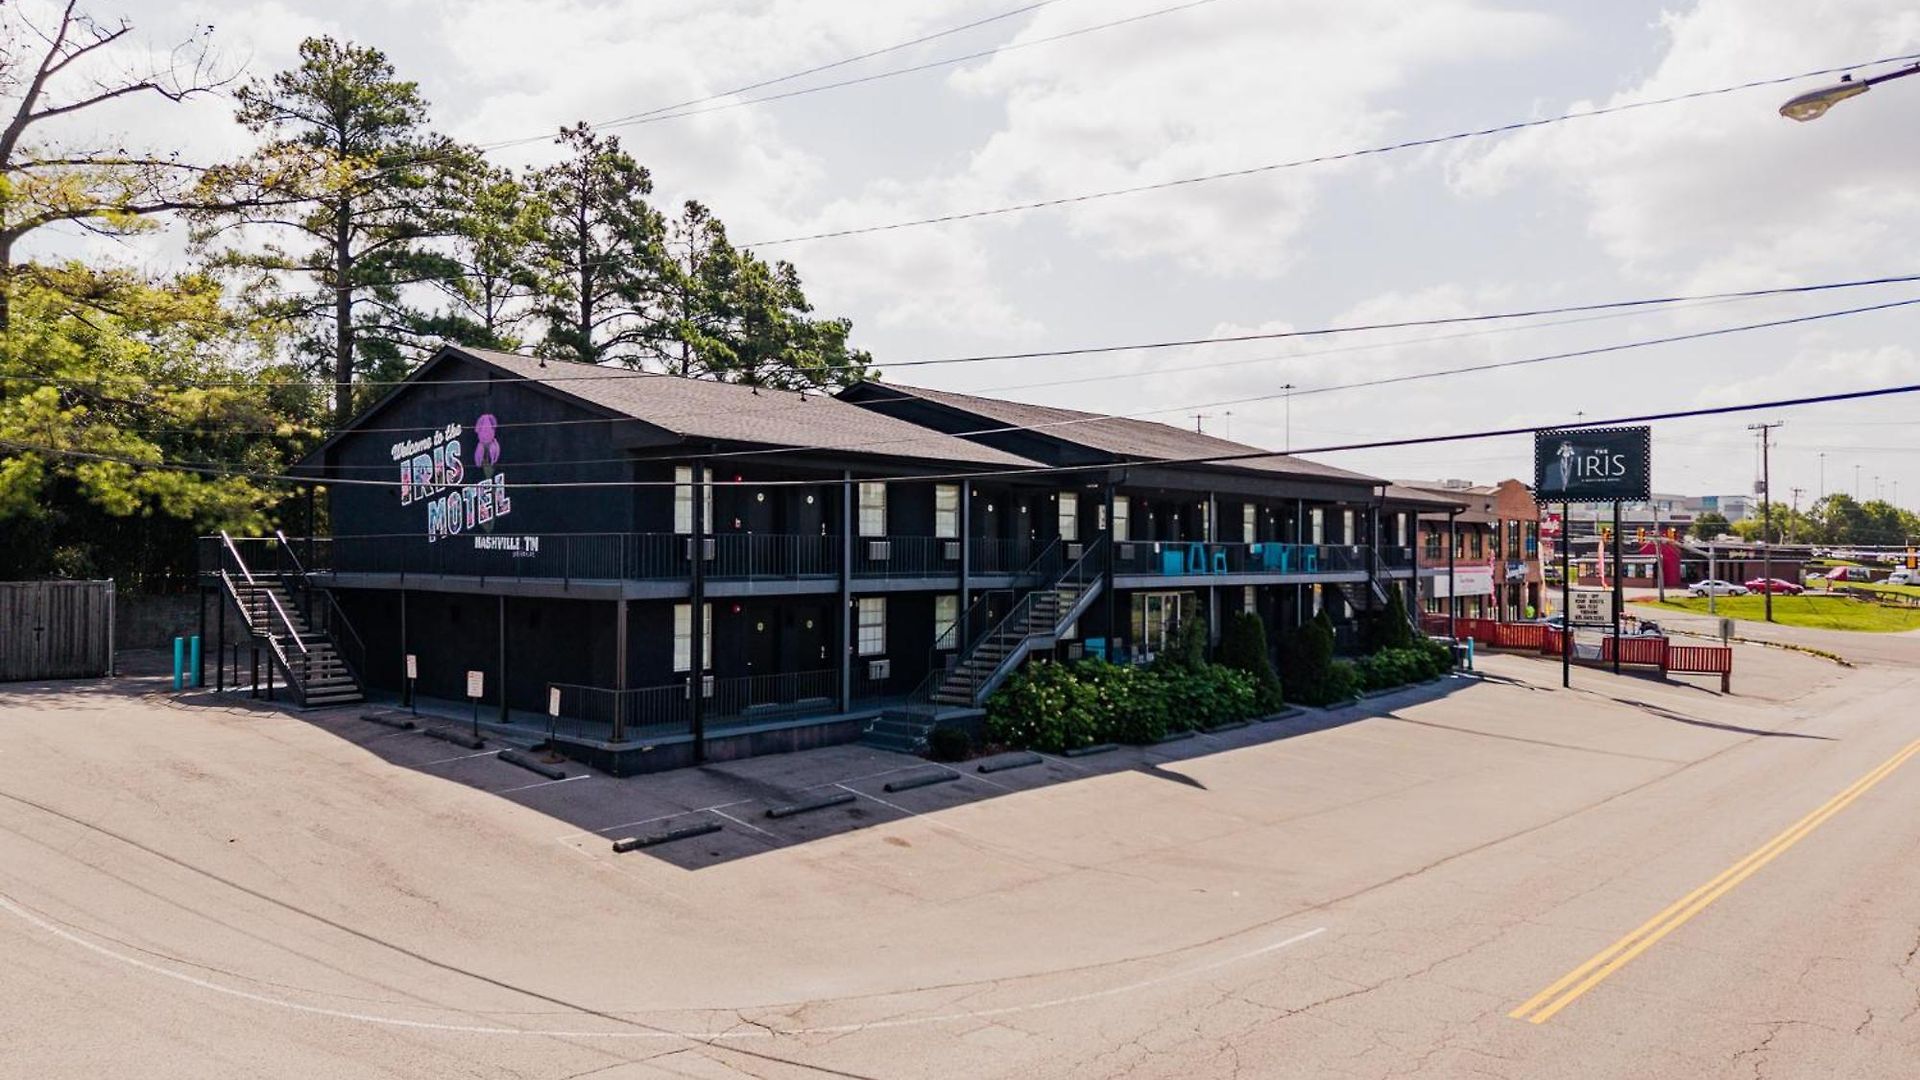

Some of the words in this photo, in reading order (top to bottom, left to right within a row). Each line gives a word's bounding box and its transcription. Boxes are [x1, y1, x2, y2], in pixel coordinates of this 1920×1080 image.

[391, 436, 432, 460] Welcome
[433, 430, 444, 446] to
[445, 423, 462, 441] the
[400, 440, 464, 506] IRIS
[1577, 454, 1625, 476] IRIS
[427, 473, 511, 543] MOTEL
[474, 536, 520, 550] NASHVILLE
[523, 536, 539, 552] TN
